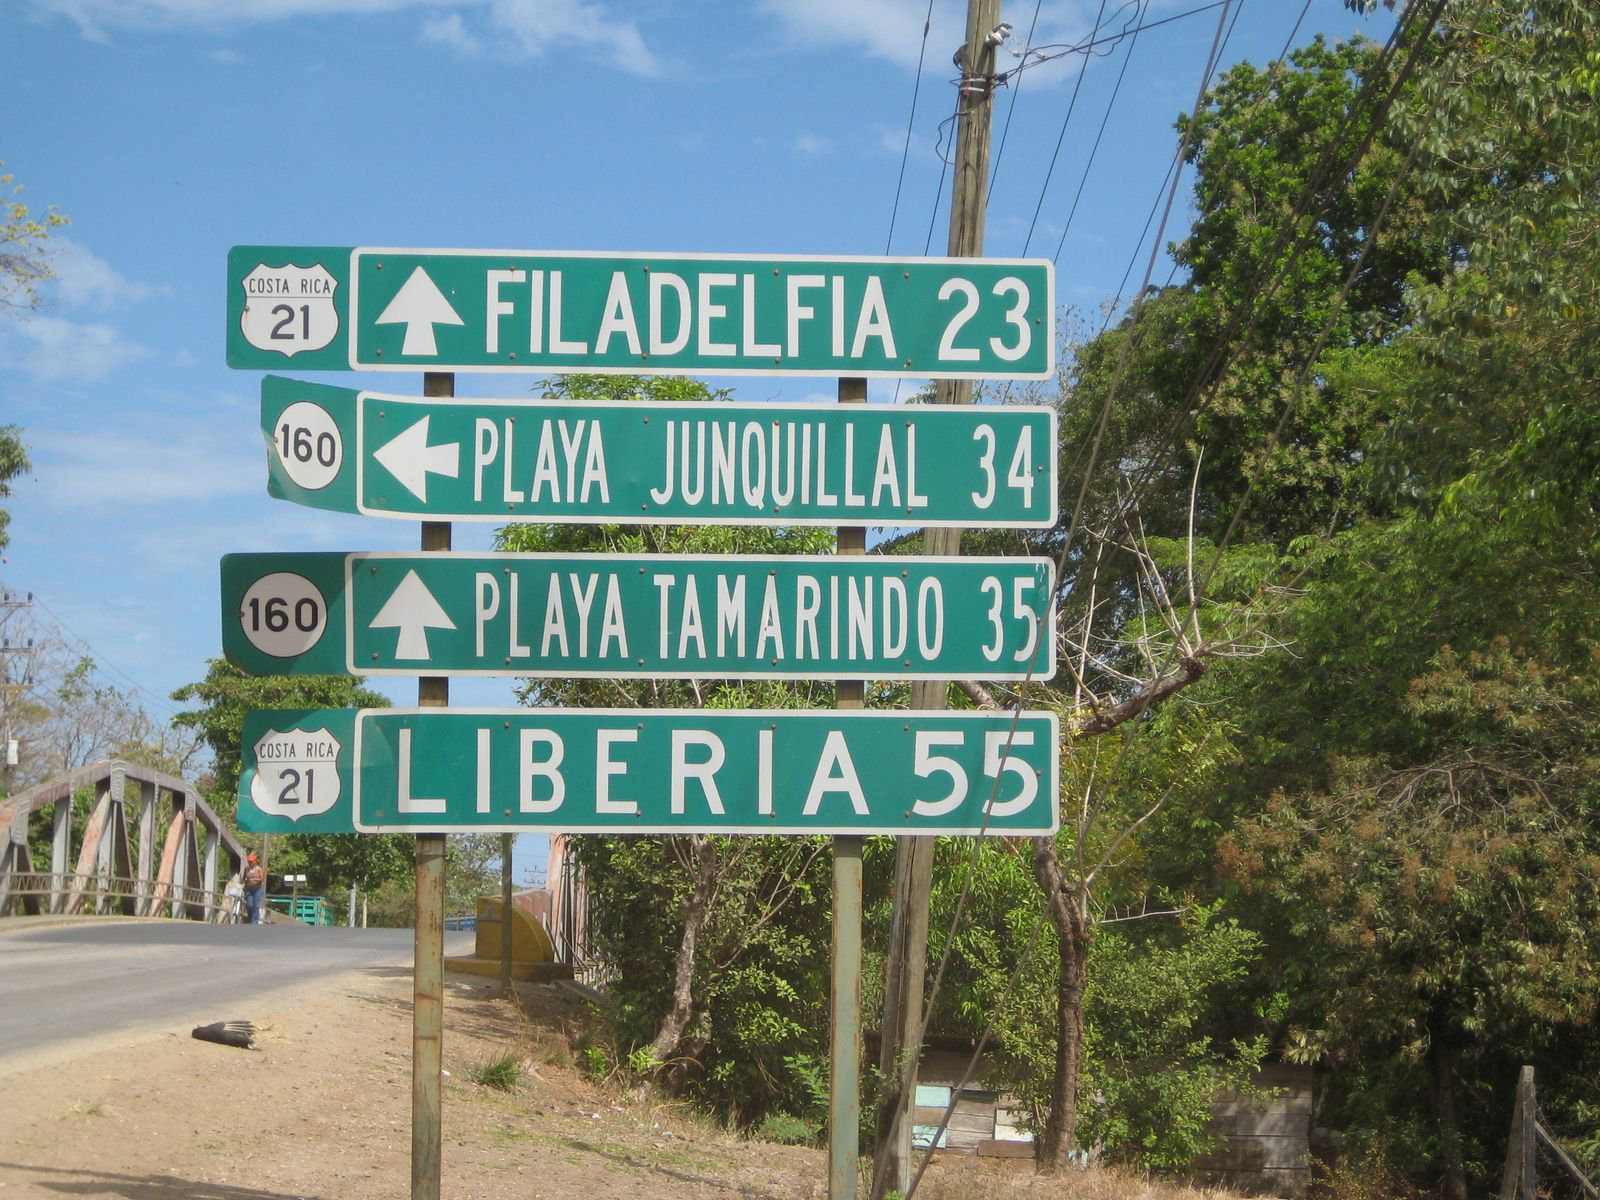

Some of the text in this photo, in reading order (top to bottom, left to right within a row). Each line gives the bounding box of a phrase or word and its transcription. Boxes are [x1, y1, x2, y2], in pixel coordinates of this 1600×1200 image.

[249, 278, 331, 295] COSTA RICA
[270, 304, 310, 340] 21
[486, 269, 1031, 361] FILADELFIA 23
[281, 423, 336, 468] 160
[474, 417, 1034, 510] PLAYA JUNQUILLAL 34
[249, 597, 319, 633] 160
[475, 572, 1038, 662] PLAYA TAMARINDO 35
[259, 743, 335, 759] COSTA RICA
[278, 769, 314, 804] 21
[398, 728, 1039, 817] LIBERIA 55
